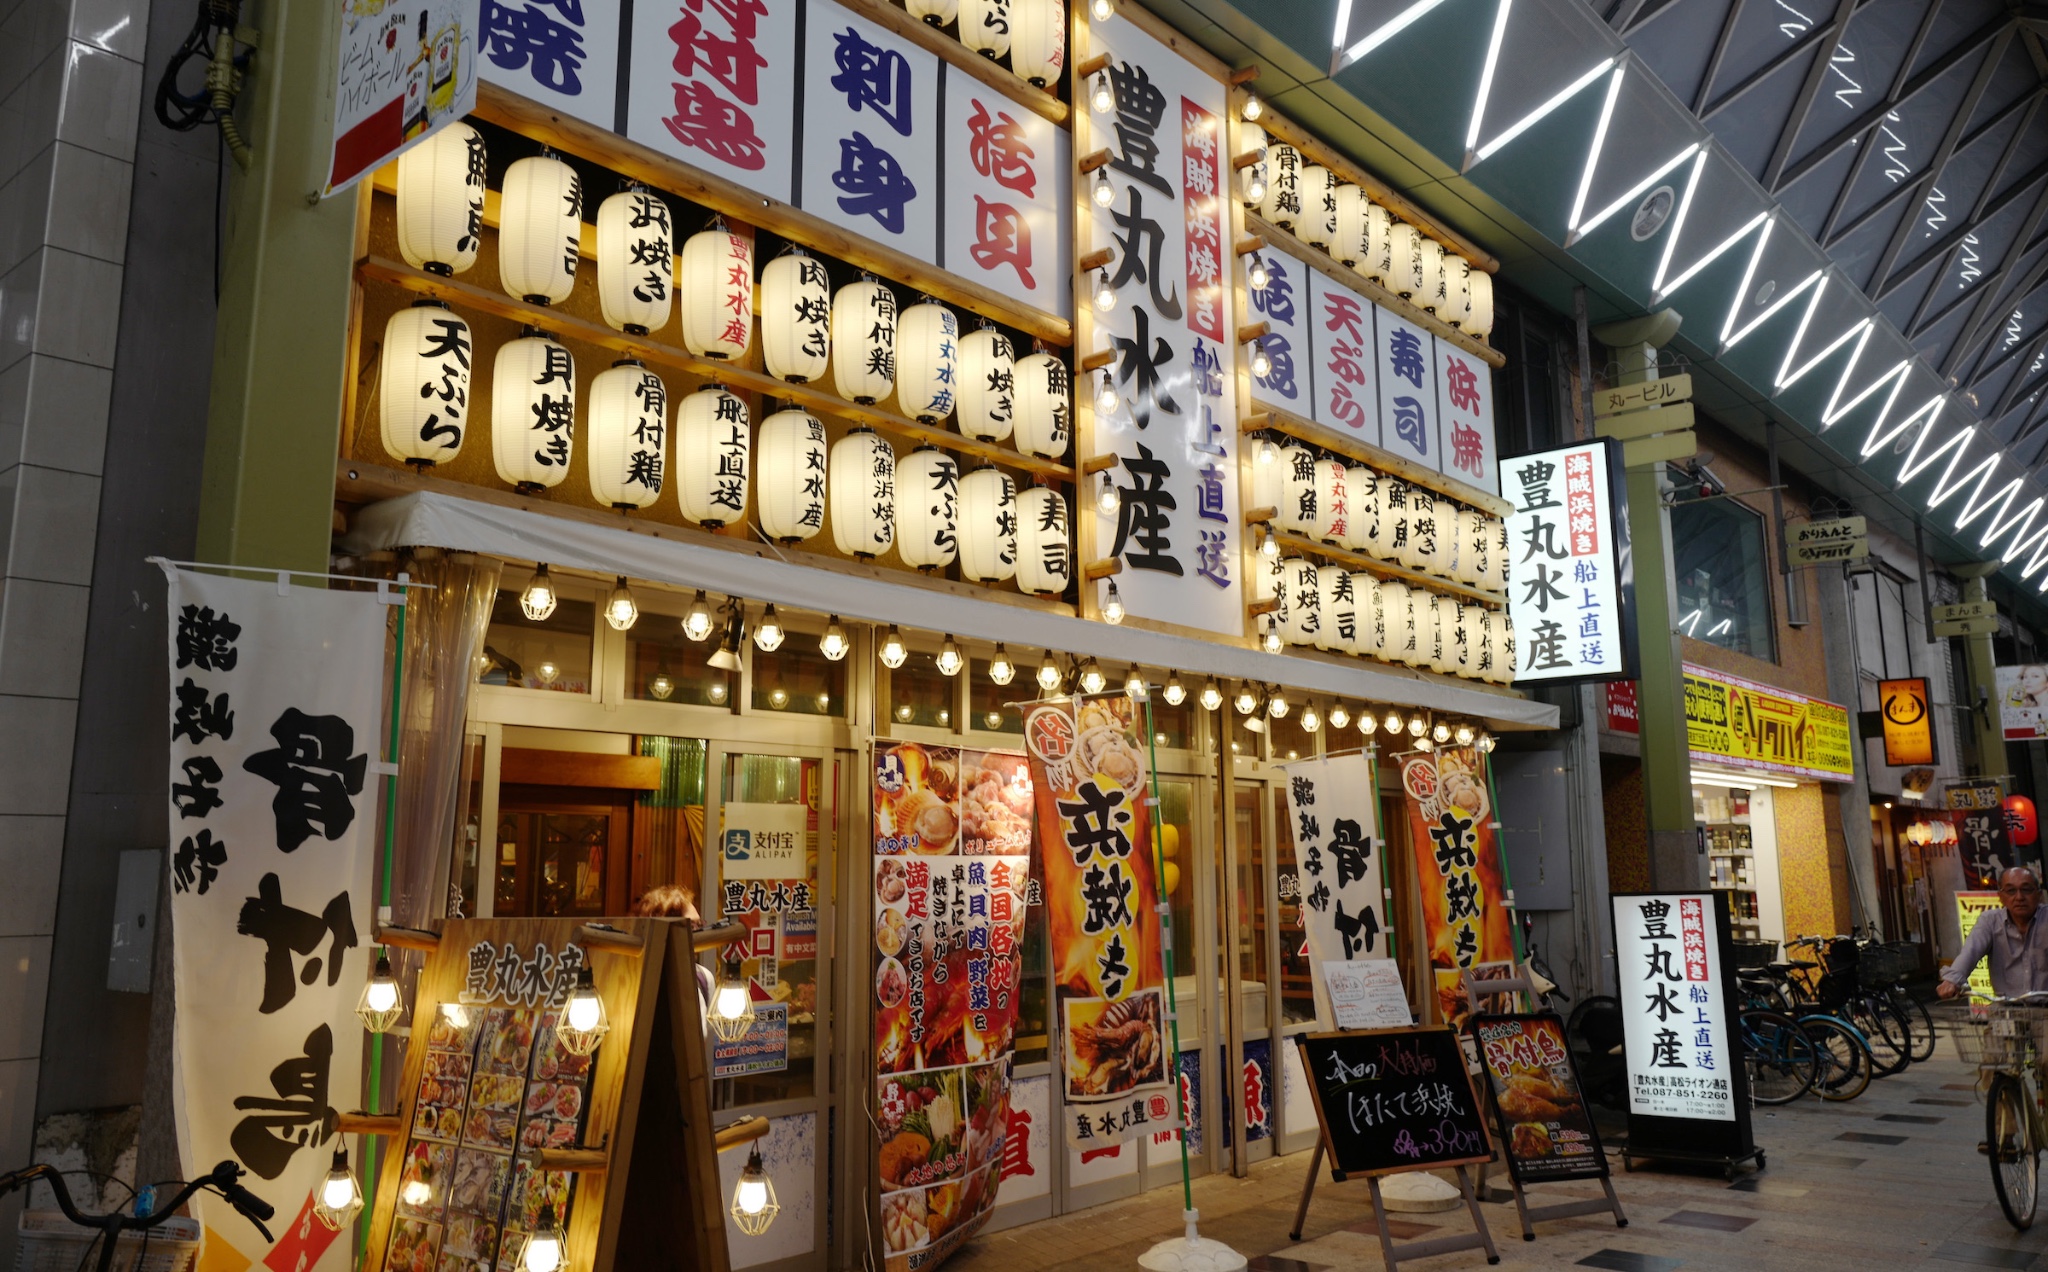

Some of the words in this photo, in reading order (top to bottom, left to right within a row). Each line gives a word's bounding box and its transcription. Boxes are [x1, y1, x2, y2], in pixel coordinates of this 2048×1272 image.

[341, 33, 374, 86] ビーム
[984, 0, 1009, 35] ら
[338, 48, 405, 123] ハイボール
[668, 0, 769, 170] 付鳥
[831, 26, 917, 234] 刺身
[967, 98, 1037, 290] 活貝
[1184, 110, 1220, 331] 海賊浜焼き
[1274, 146, 1301, 215] 骨付鶏
[629, 195, 672, 303] 浜焼き
[718, 234, 751, 349] 豊丸水産
[794, 261, 829, 358] 肉焼き
[866, 288, 896, 384] 骨付鶏
[1108, 60, 1184, 577] 豊丸水産
[1251, 258, 1298, 399] 活魚
[418, 319, 470, 449] 天ぷら
[922, 311, 958, 415] 豊丸水産
[987, 335, 1014, 422] 肉焼き
[1323, 291, 1366, 428] 天ぷら
[1390, 327, 1427, 456] 寿司
[532, 344, 574, 466] 貝焼き
[621, 373, 666, 493] 骨付鶏
[1446, 354, 1484, 479] 浜焼
[710, 393, 750, 511] 船上直送
[797, 418, 826, 529] 豊丸水産
[870, 436, 895, 544] 海鮮浜焼き
[1191, 337, 1232, 590] 船上直送
[1291, 451, 1316, 522] 鮮魚
[929, 461, 958, 553] 天ぷら
[996, 476, 1018, 565] 貝焼き
[1037, 493, 1068, 580] 寿司
[1326, 463, 1347, 537] 豊丸水産
[1388, 482, 1408, 548] 鮮魚
[1414, 496, 1436, 555] 肉焼き
[1472, 516, 1488, 573] 浜焼き
[1567, 454, 1597, 554] 海賊浜焼き
[1798, 525, 1852, 541] おりえんと
[1296, 568, 1320, 633] 肉焼き
[1332, 572, 1355, 642] 寿司
[1516, 460, 1573, 671] 豊丸水産
[1574, 560, 1605, 665] 船上直送
[1945, 604, 1982, 617] まんま
[1742, 691, 1806, 764] ソクハイ
[754, 831, 793, 849] 支付宝
[755, 850, 793, 859] ALIPAY
[725, 883, 811, 914] 豊丸水産
[933, 876, 948, 985] 焼きながら
[951, 864, 966, 949] 卓上にて
[990, 860, 1014, 1009] 全国各地の
[1682, 900, 1706, 980] 海賊浜焼き
[461, 941, 583, 1007] 豊丸水産
[722, 928, 776, 962] 入口
[1639, 899, 1688, 1069] 豊丸水産
[1486, 1028, 1567, 1079] 骨付鳥
[1688, 984, 1716, 1071] 船上直送
[1348, 1082, 1465, 1135] ほたて浜焼
[1634, 1086, 1728, 1100] Tel.087-851-2260
[909, 1152, 966, 1185] 大地の恵み
